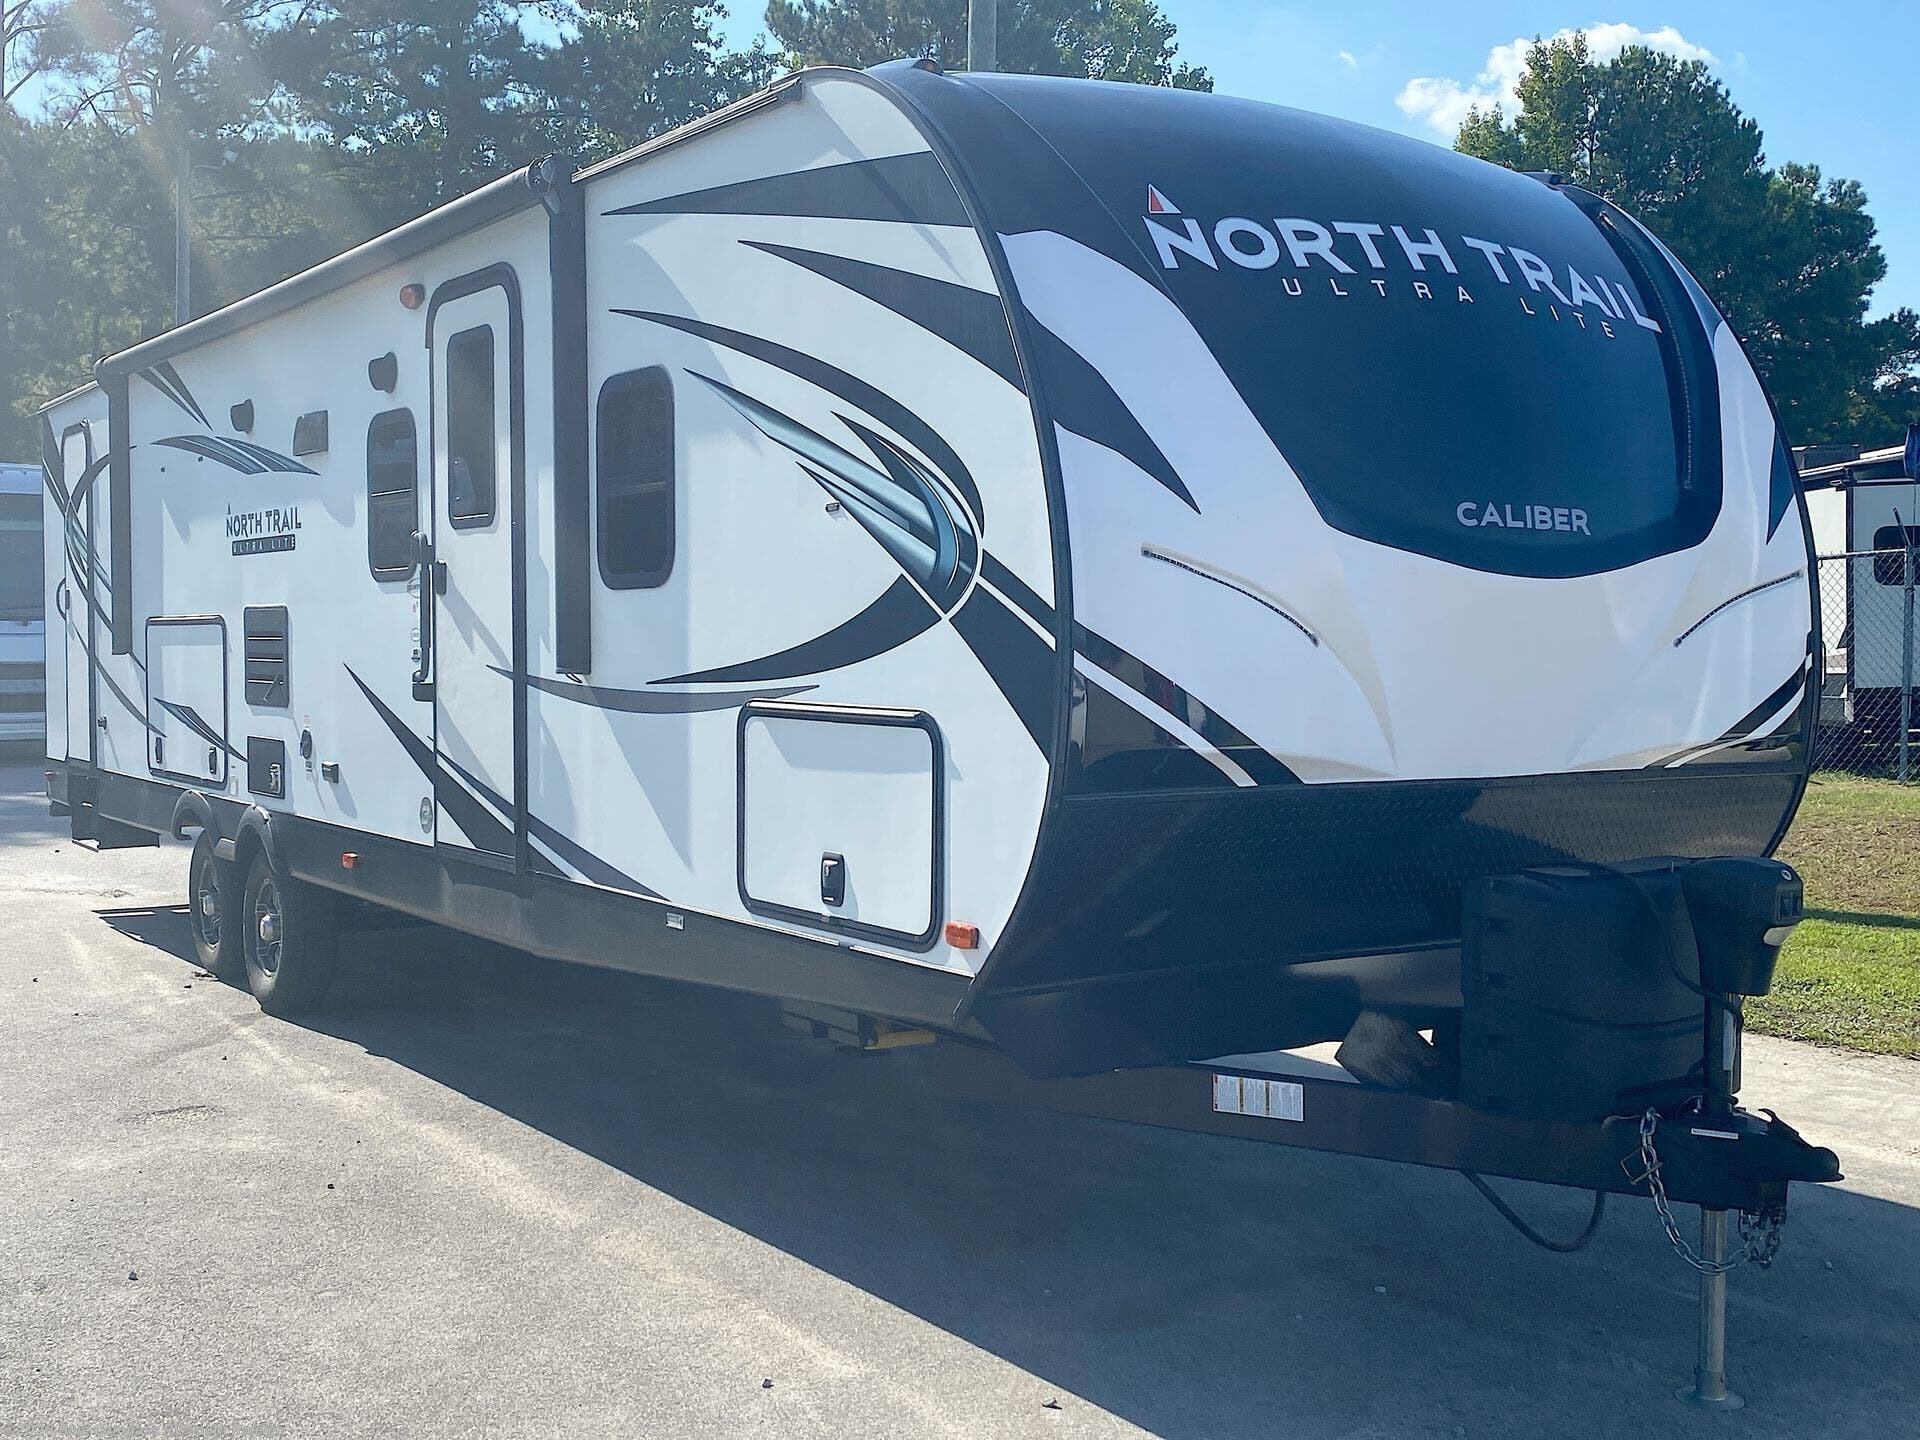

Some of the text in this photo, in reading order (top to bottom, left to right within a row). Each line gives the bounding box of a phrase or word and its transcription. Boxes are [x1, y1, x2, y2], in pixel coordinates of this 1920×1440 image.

[1142, 215, 1663, 334] NORTH TRAIL
[1281, 277, 1616, 340] ULTRA LITE
[226, 506, 301, 537] NORTH TRAIL
[1456, 501, 1592, 536] CALIBER
[233, 537, 295, 553] ULTRA LITE
